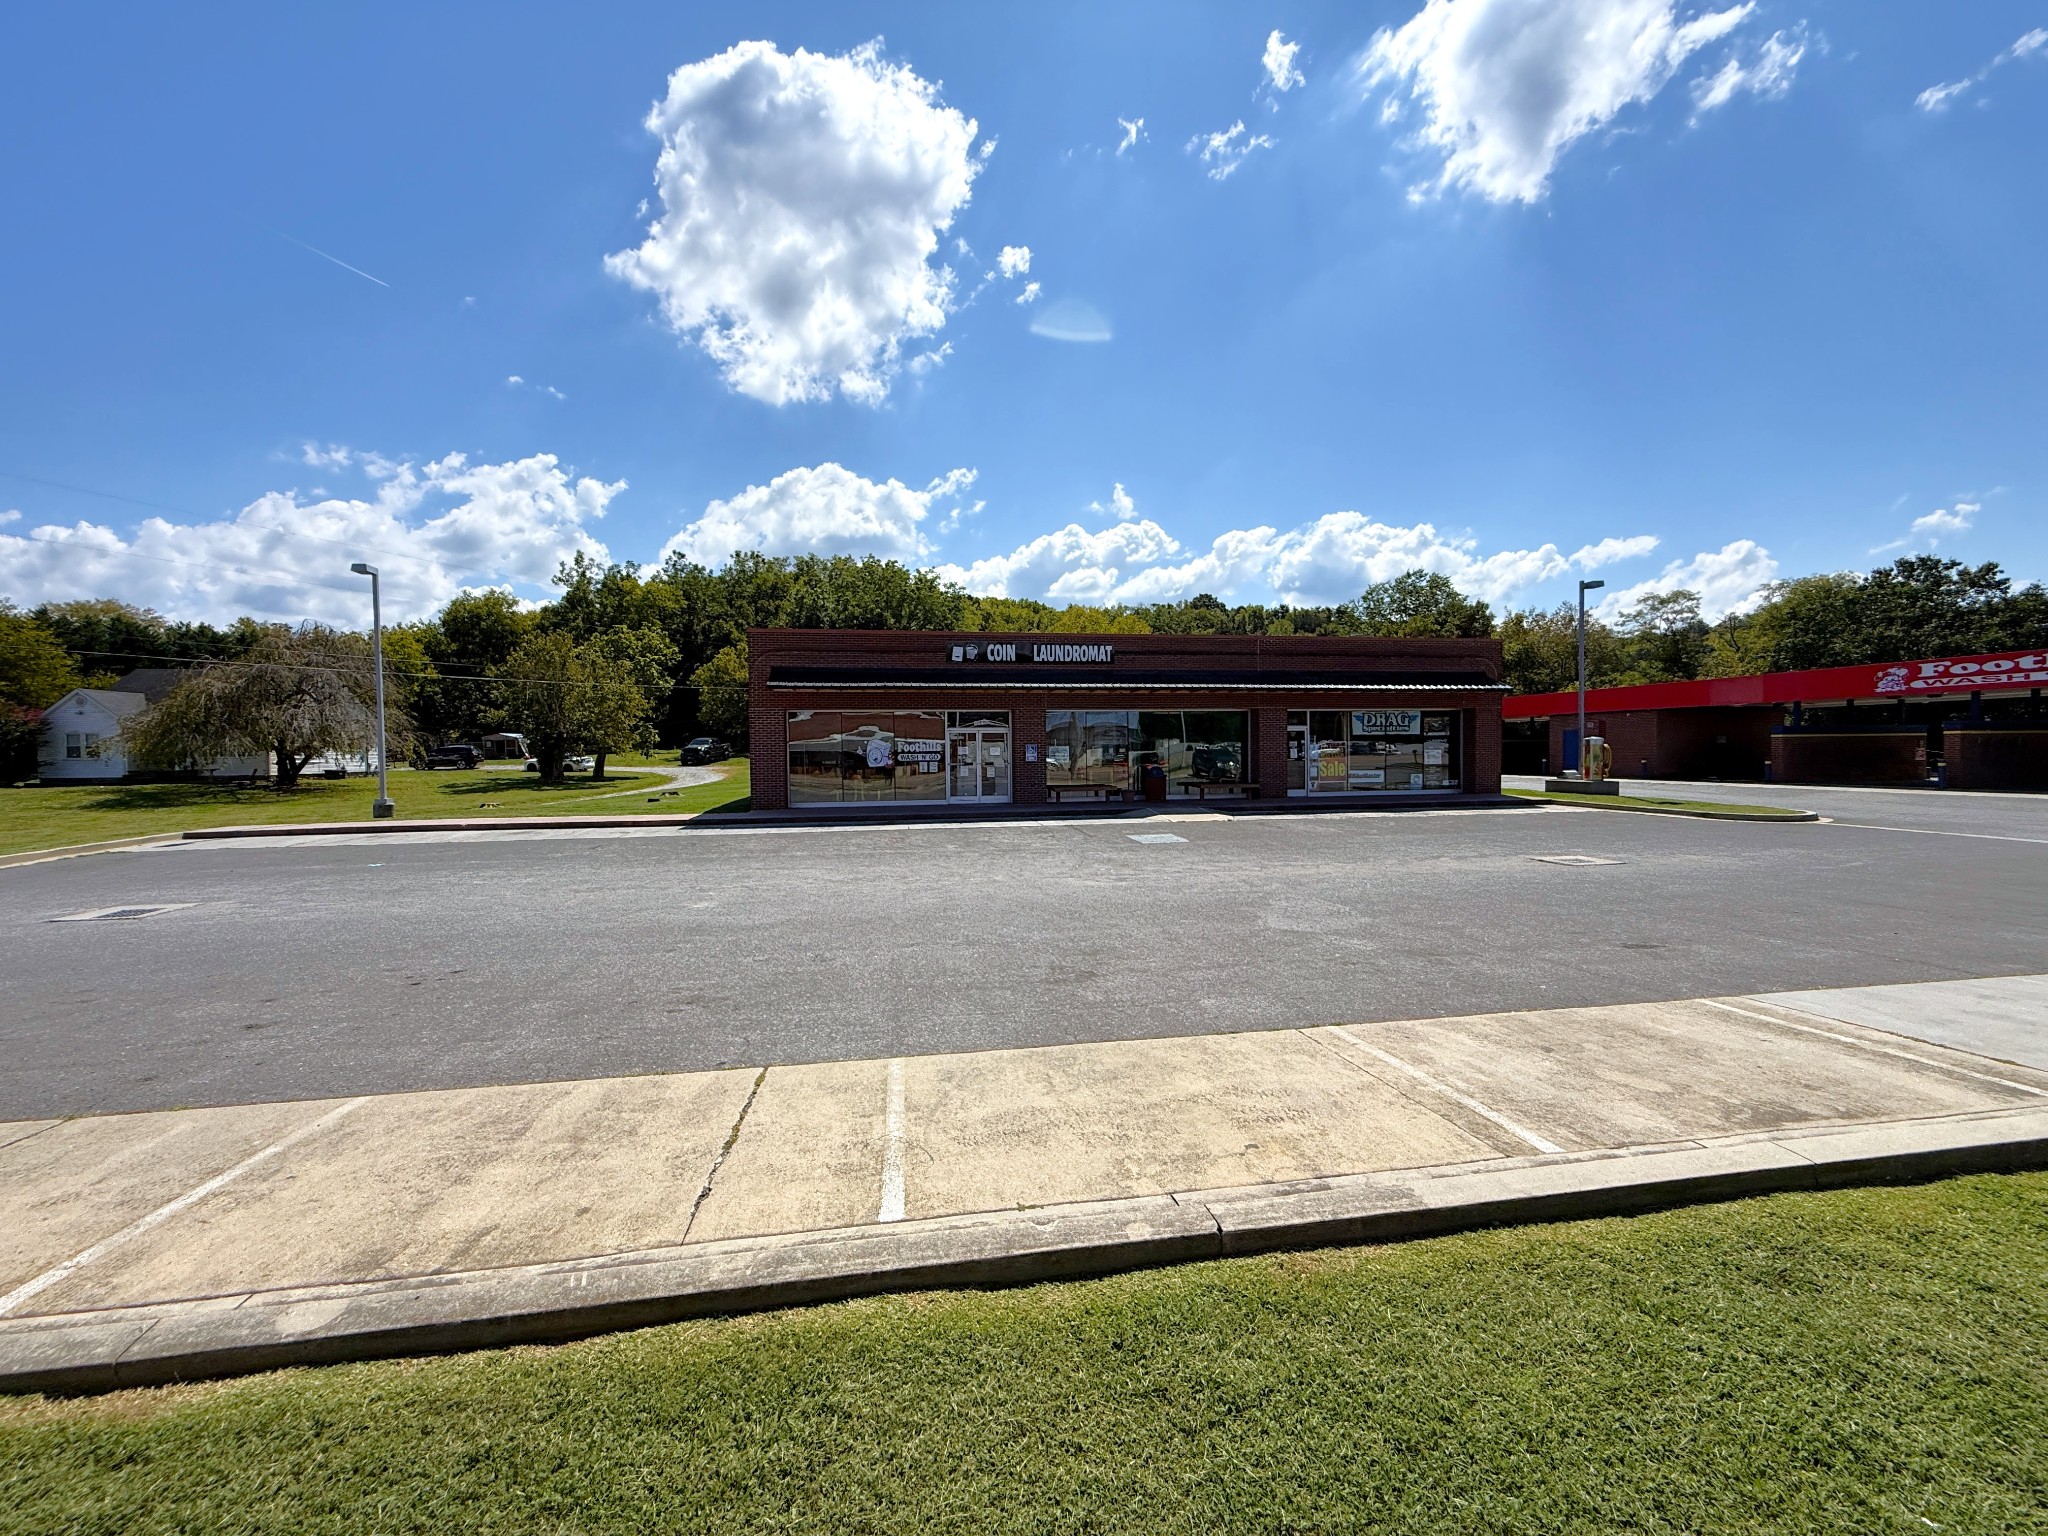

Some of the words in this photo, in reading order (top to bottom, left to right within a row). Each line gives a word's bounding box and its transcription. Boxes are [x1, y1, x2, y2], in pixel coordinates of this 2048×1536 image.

[987, 643, 1016, 662] COIN
[1033, 644, 1113, 662] LAUNDROMAT
[1918, 653, 2048, 677] Foot
[1922, 673, 2031, 686] WASH
[1363, 712, 1410, 726] DRAG
[897, 741, 942, 752] Foothills
[1320, 761, 1346, 777] Sale
